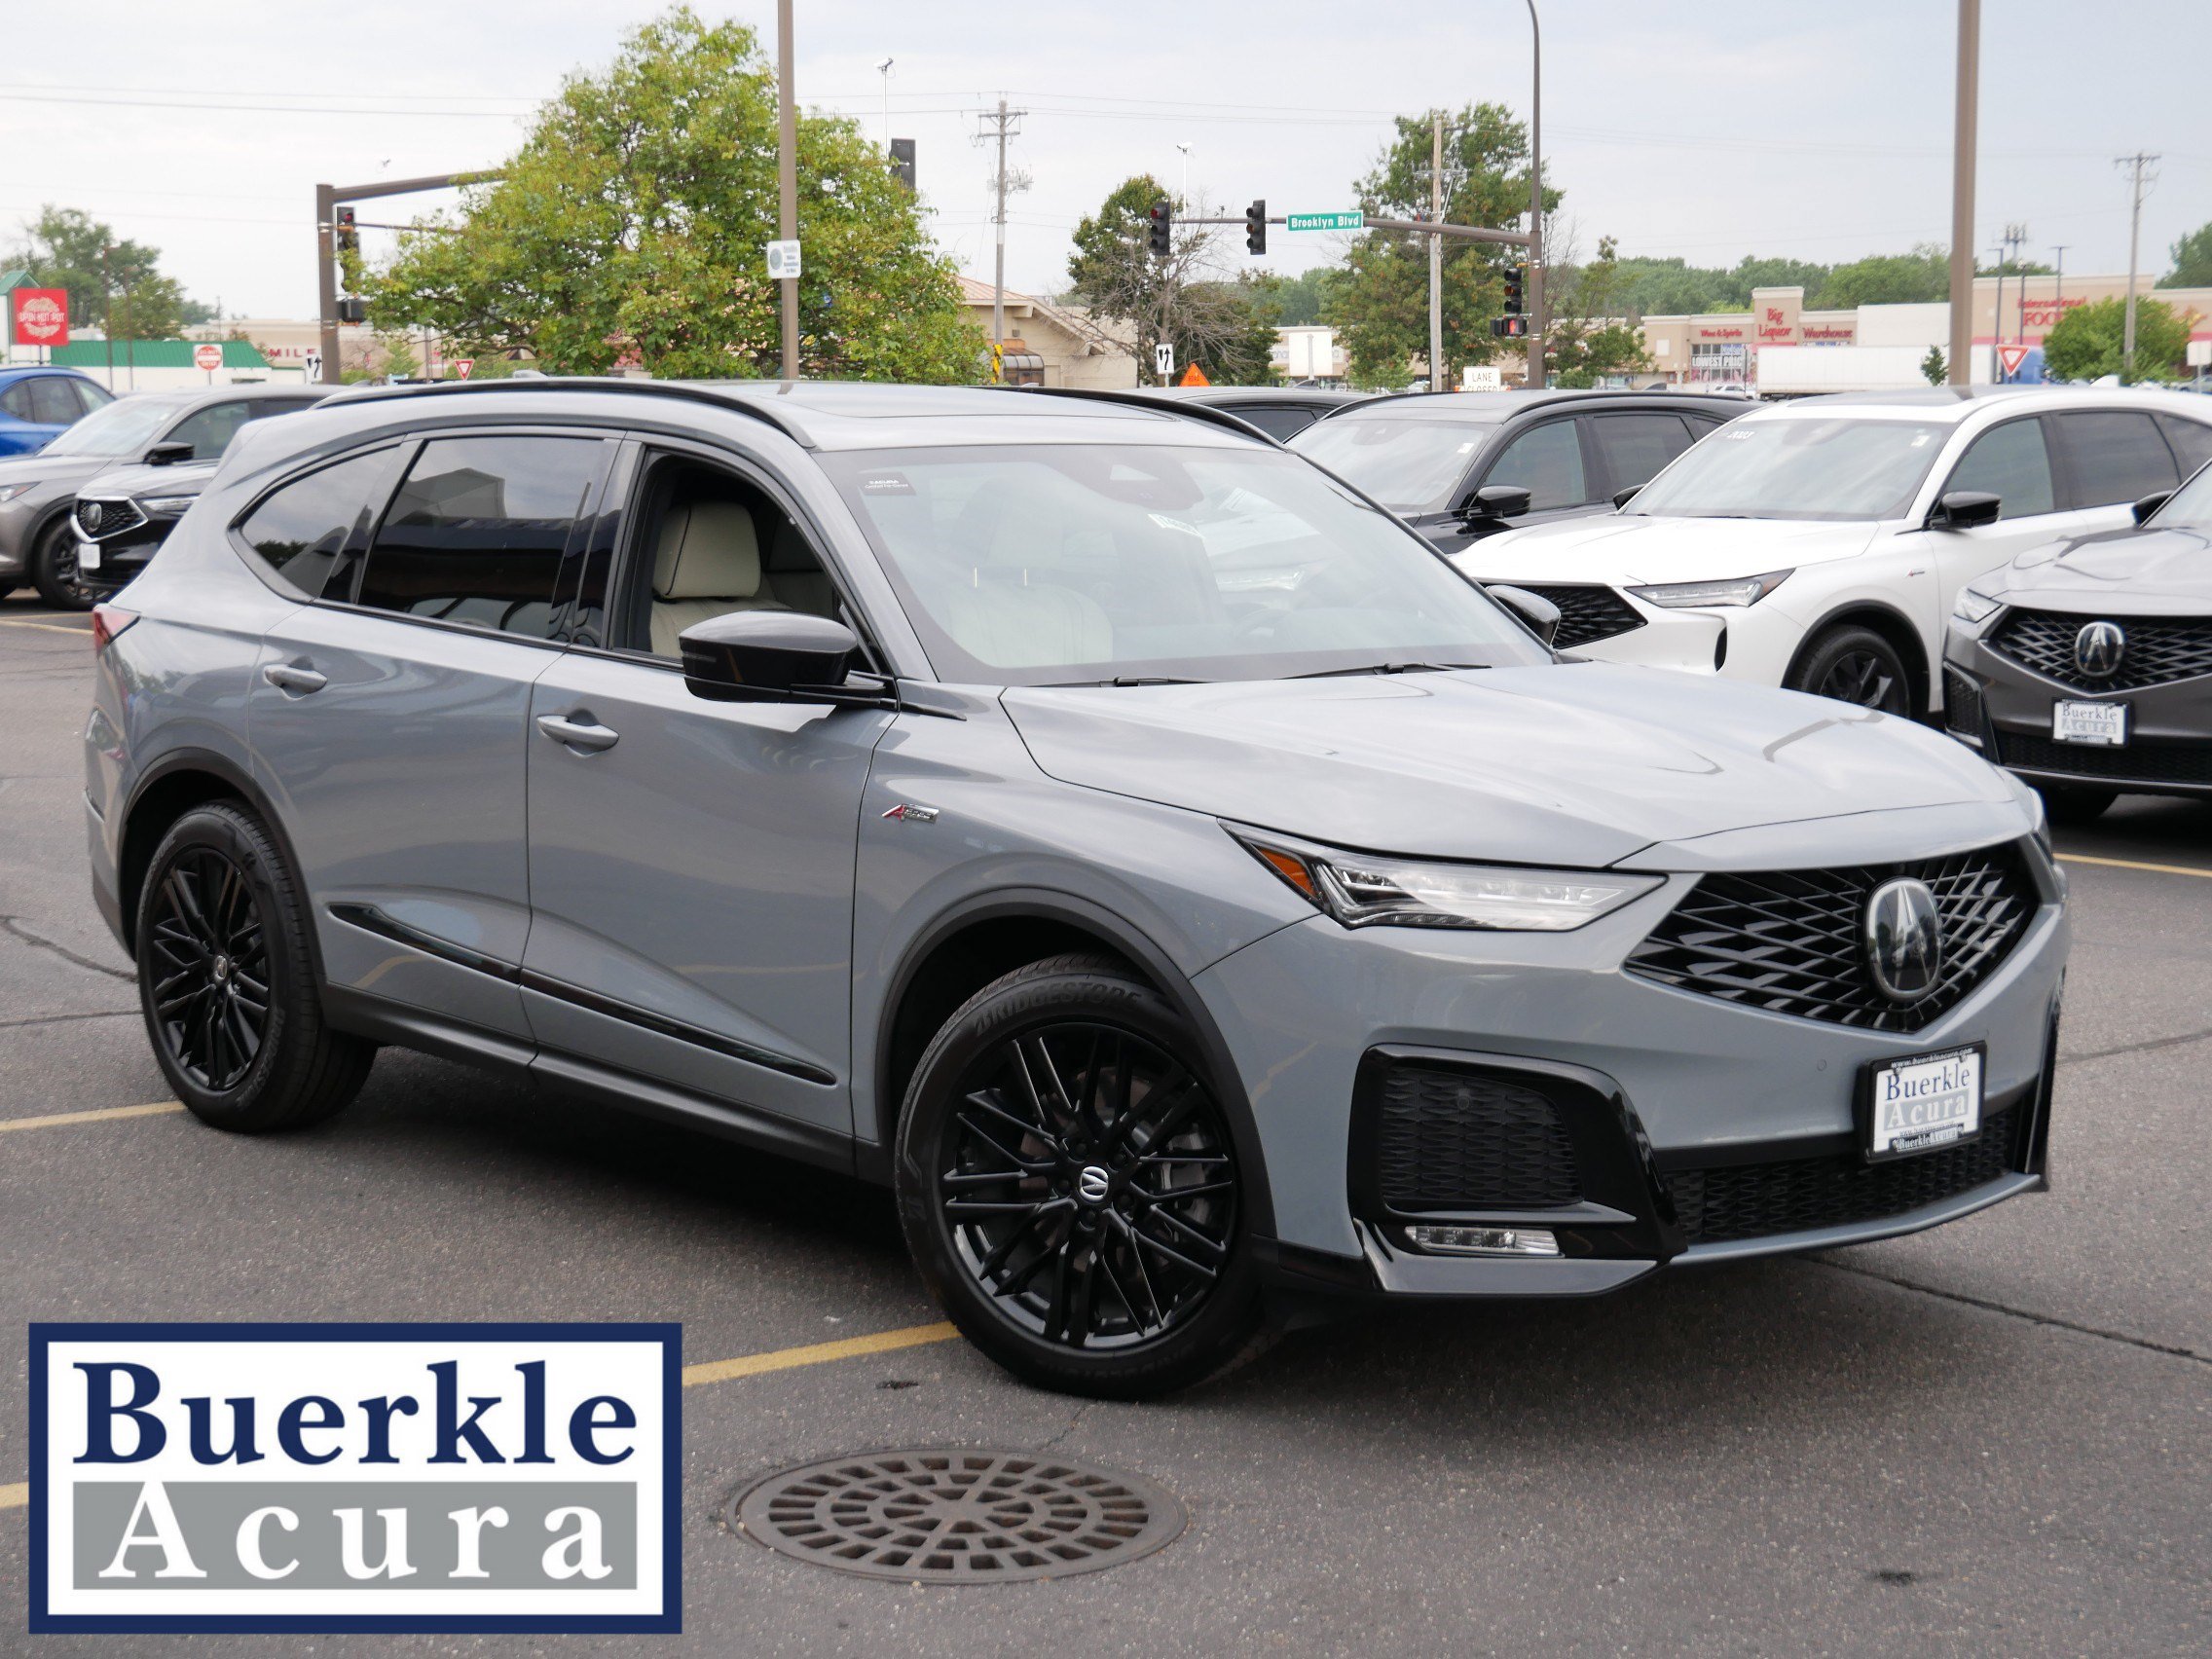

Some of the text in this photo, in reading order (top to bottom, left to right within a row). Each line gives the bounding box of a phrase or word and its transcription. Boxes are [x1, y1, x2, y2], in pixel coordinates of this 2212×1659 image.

[1291, 215, 1359, 230] Brooklyn Blvd
[1766, 308, 1784, 326] Big
[1758, 324, 1792, 341] Liquor
[1802, 324, 1854, 339] Warehouse
[1692, 356, 1722, 367] LOWEST
[1472, 372, 1493, 382] LANE
[2062, 703, 2118, 720] Buerkle
[2063, 719, 2116, 733] Acura
[1886, 1063, 1971, 1101] Buerkle
[1889, 1094, 1965, 1128] Acura
